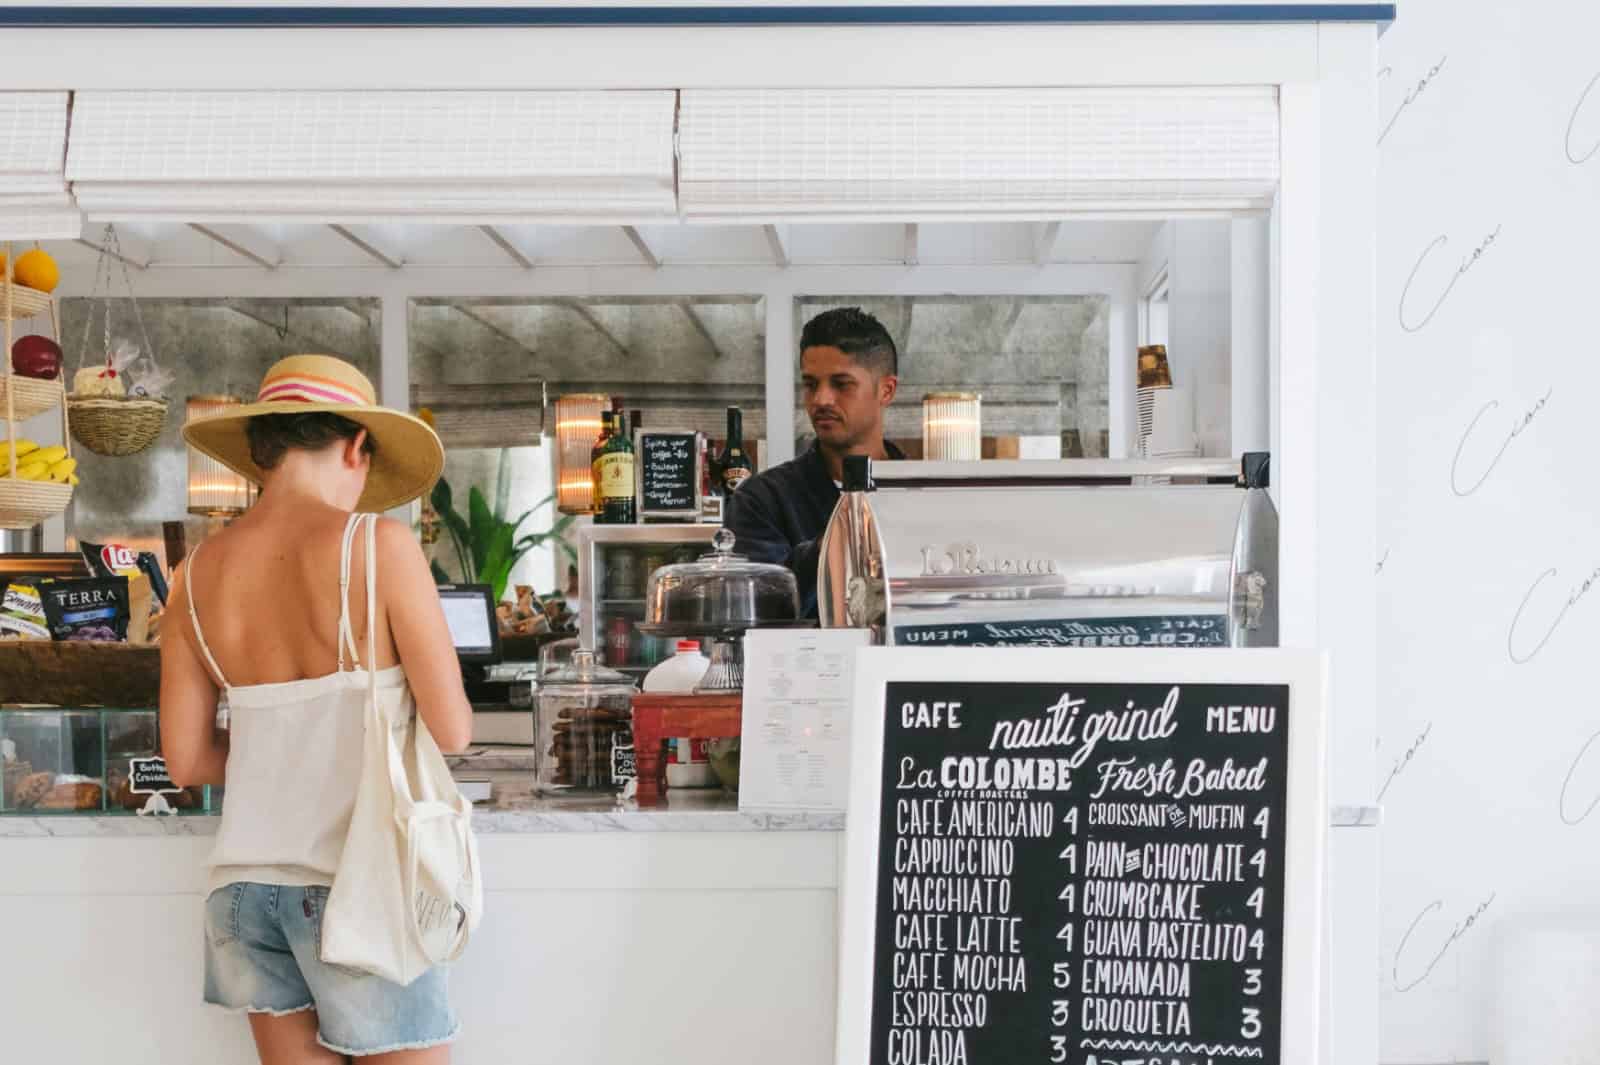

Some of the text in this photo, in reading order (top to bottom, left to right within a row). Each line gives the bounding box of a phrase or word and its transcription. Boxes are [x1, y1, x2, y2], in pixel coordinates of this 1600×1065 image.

[56, 588, 117, 606] TERRA
[901, 702, 962, 729] CAFE
[988, 692, 1085, 750] nauti
[1070, 686, 1180, 768] grind
[1205, 706, 1276, 734] MENU
[896, 756, 1072, 792] La COLOMBE
[1090, 757, 1269, 799] Fresh Baked
[896, 798, 1078, 838] CAFE AMERICANO 4
[1088, 802, 1168, 827] CROISSANT
[1189, 804, 1245, 830] MUFFIN
[1253, 806, 1270, 840] 4
[895, 837, 1077, 876] CAPPUCCINO 4
[1085, 841, 1126, 878] PAIN
[1142, 843, 1245, 882] CHOCOLATE
[1249, 848, 1267, 878] 4
[893, 876, 1075, 914] MACCHIATO 4
[1083, 880, 1265, 921] CRUMBCAKE 4
[895, 914, 1074, 954] CAFE LATTE 4
[1083, 919, 1265, 963] GUAVA PASTELITO 4
[893, 952, 1071, 993] CAFE MOCHA 5
[1082, 958, 1263, 998] EMPANADA 3
[892, 990, 1070, 1028] ESPRESSO 3
[1081, 997, 1262, 1039] CROQUETA 3
[887, 1028, 1068, 1065] COLADA 3
